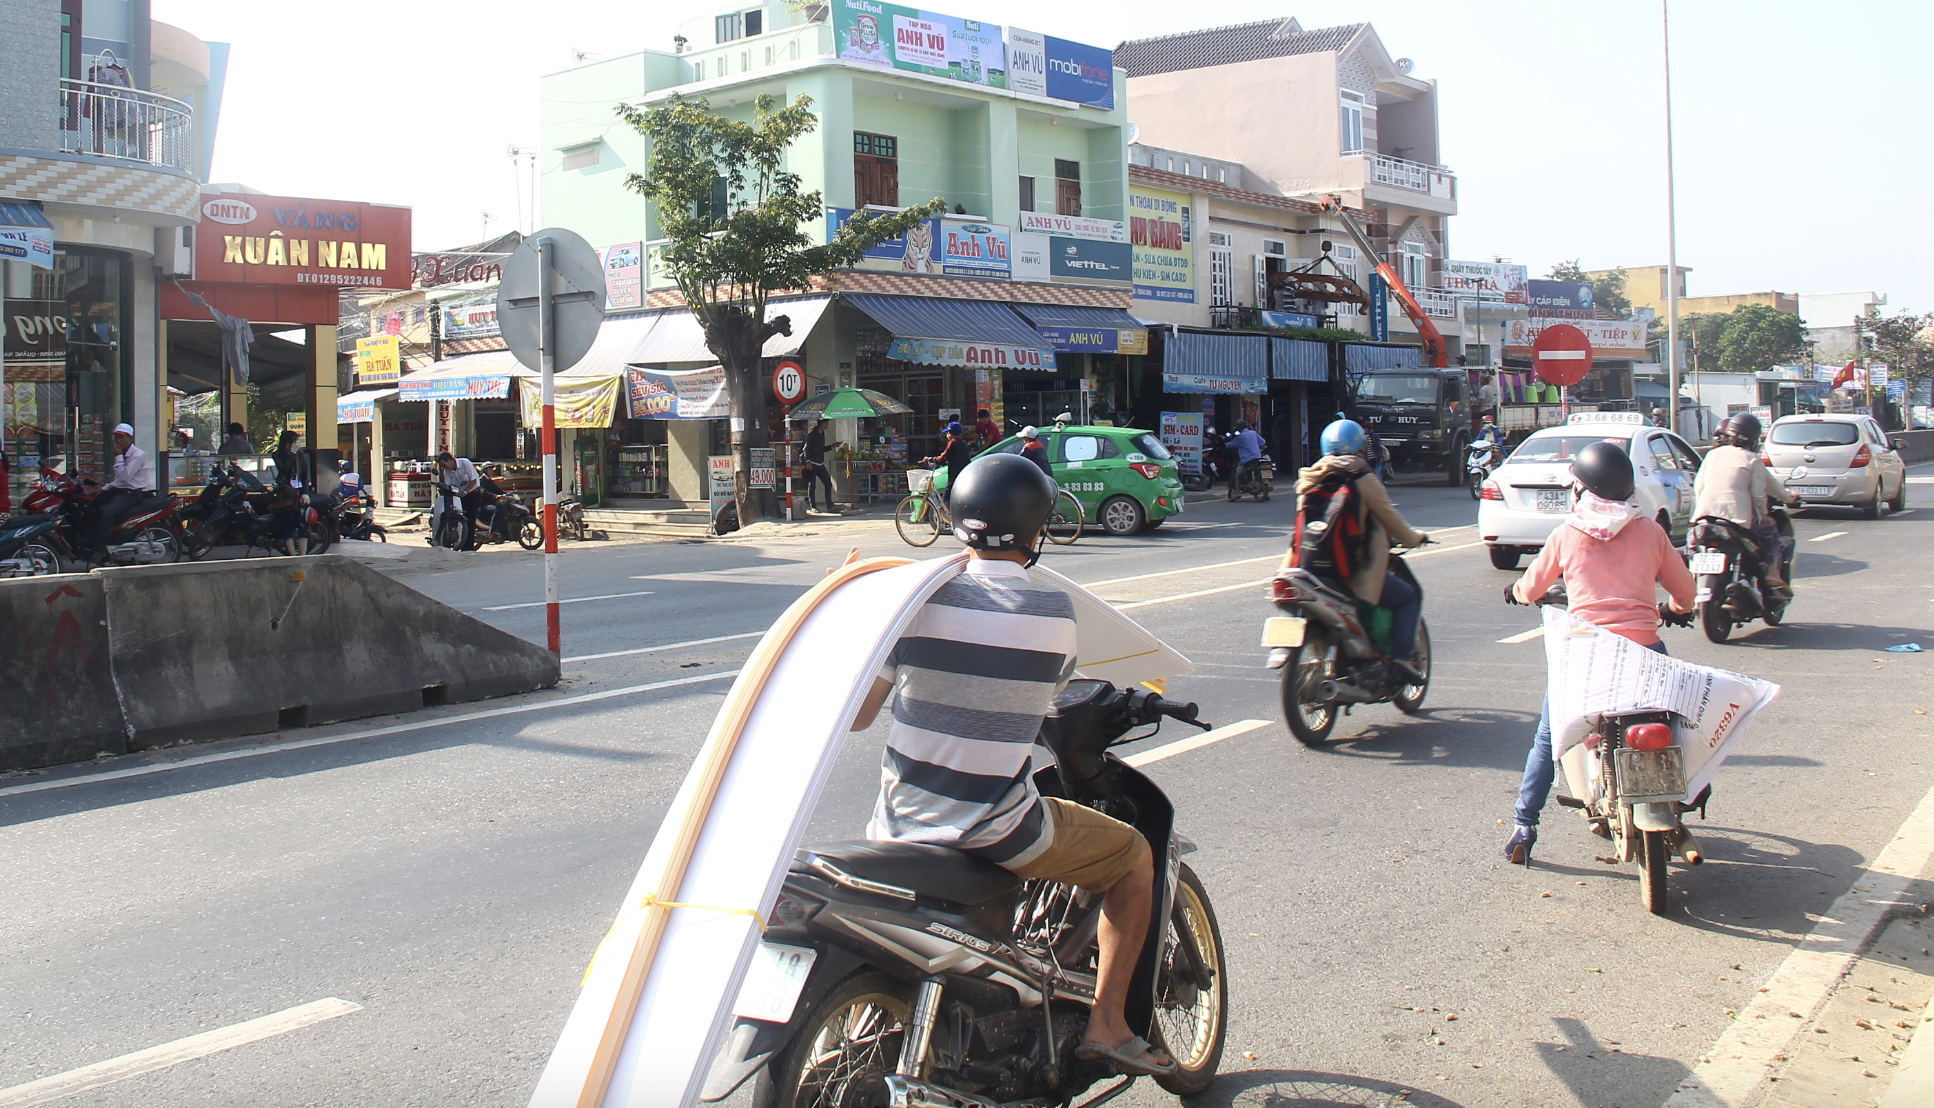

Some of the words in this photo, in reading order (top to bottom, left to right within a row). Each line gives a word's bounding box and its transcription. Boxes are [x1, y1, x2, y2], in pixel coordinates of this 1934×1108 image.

[845, 0, 882, 14] NutiFood
[965, 20, 980, 31] Nuti
[897, 28, 923, 47] ANH
[926, 33, 944, 51] VŨ
[1013, 50, 1030, 72] ANH
[1031, 52, 1043, 75] VŨ
[1050, 58, 1108, 81] mobifone
[1154, 198, 1160, 211] DI
[210, 204, 250, 220] DNTN
[272, 201, 359, 232] VÀNG
[1026, 216, 1052, 229] ANH
[1054, 217, 1071, 230] VŨ
[1148, 216, 1182, 250] SÁNG
[224, 230, 309, 267] XUÂN
[318, 240, 387, 270] NAM
[947, 232, 981, 258] Anh
[986, 236, 1007, 260] Vũ
[1021, 256, 1032, 264] ANH
[1066, 260, 1108, 270] VIETTEL
[421, 256, 502, 284] Xuân
[1161, 271, 1170, 282] SIM
[1171, 272, 1186, 283] CARD
[1536, 295, 1551, 305] CÁP
[1552, 297, 1570, 307] ĐIỆN
[468, 312, 487, 324] HUY
[1069, 332, 1088, 344] ANH
[1090, 332, 1103, 345] VŨ
[1601, 327, 1628, 341] TIỆP
[966, 346, 1006, 364] Anh
[1014, 349, 1041, 366] Vũ
[366, 358, 375, 372] HÀ
[375, 356, 392, 371] TUẤN
[467, 380, 485, 395] HUY
[631, 385, 649, 399] SIÊU
[650, 379, 668, 395] SỐC
[780, 373, 798, 392] 10T
[344, 406, 352, 419] HÀ
[354, 402, 369, 419] TUẤN
[439, 405, 449, 425] HUY
[1369, 415, 1382, 423] TƯ
[1398, 416, 1418, 424] HUY
[1627, 414, 1639, 422] 68
[385, 421, 400, 430] HÀ
[403, 421, 427, 430] TUẤ
[1164, 425, 1176, 434] SIM
[1180, 425, 1198, 435] CARD
[439, 428, 449, 451] TÍN
[713, 460, 730, 468] ANH
[750, 469, 774, 483] 49.000
[1071, 482, 1081, 491] 83
[1083, 482, 1092, 491] 83
[1094, 482, 1104, 491] 83
[1544, 491, 1559, 500] 43A
[1709, 702, 1740, 748] V6320
[925, 922, 991, 951] SIRIUS
